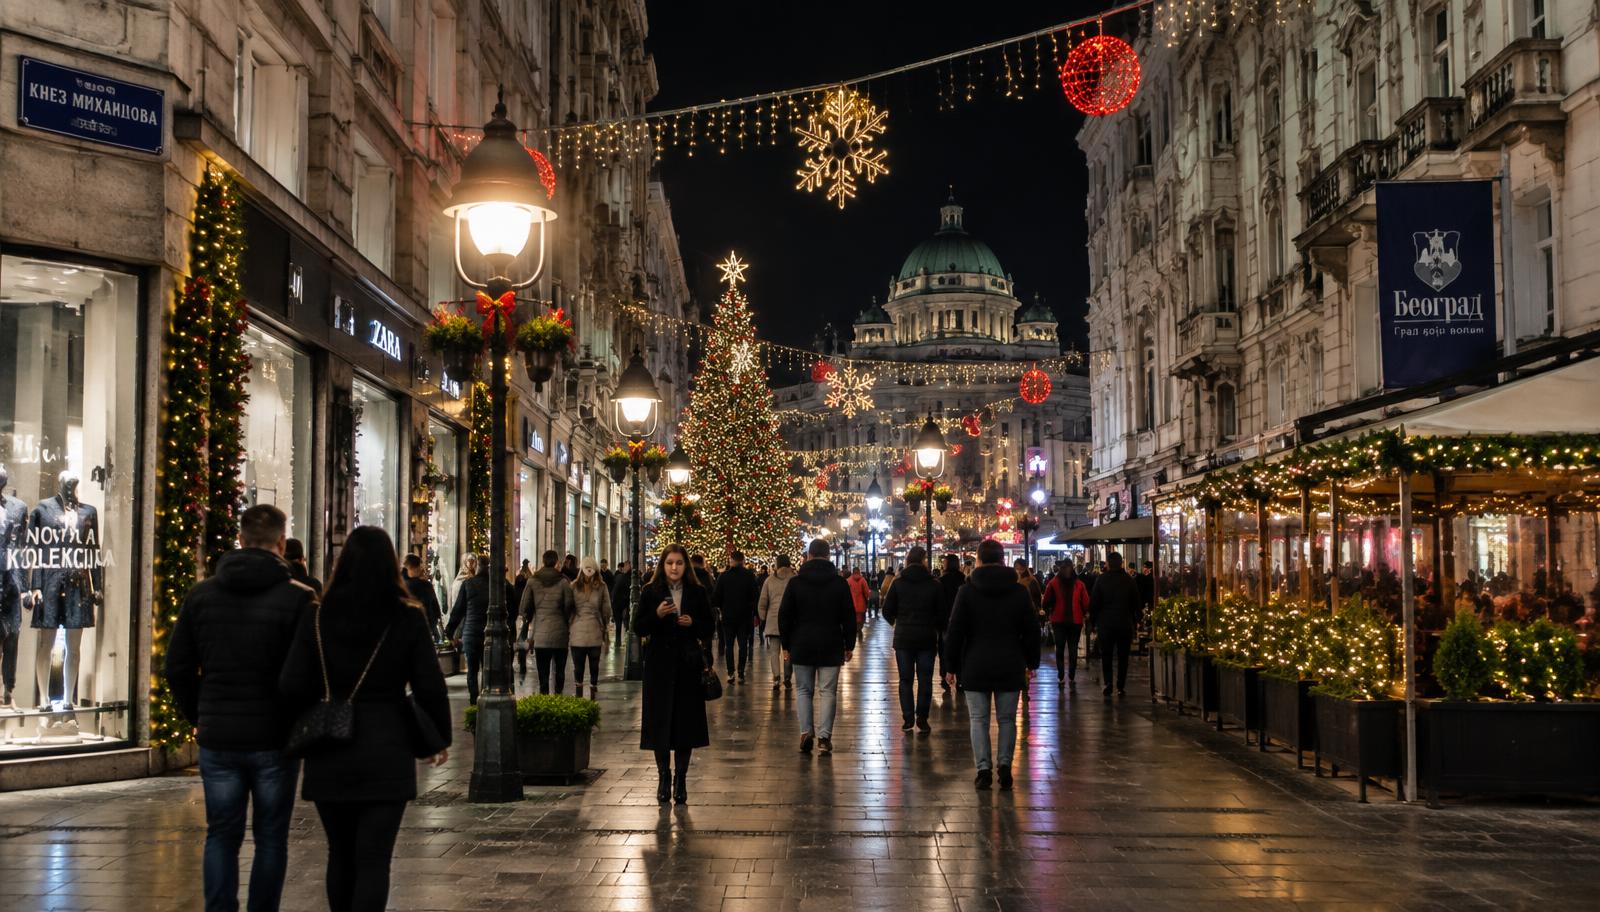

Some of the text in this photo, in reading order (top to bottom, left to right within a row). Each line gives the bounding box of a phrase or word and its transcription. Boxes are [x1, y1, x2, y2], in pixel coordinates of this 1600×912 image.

[29, 82, 67, 105] КНЕЗ
[1393, 290, 1484, 323] Београд
[369, 319, 402, 362] ZARA
